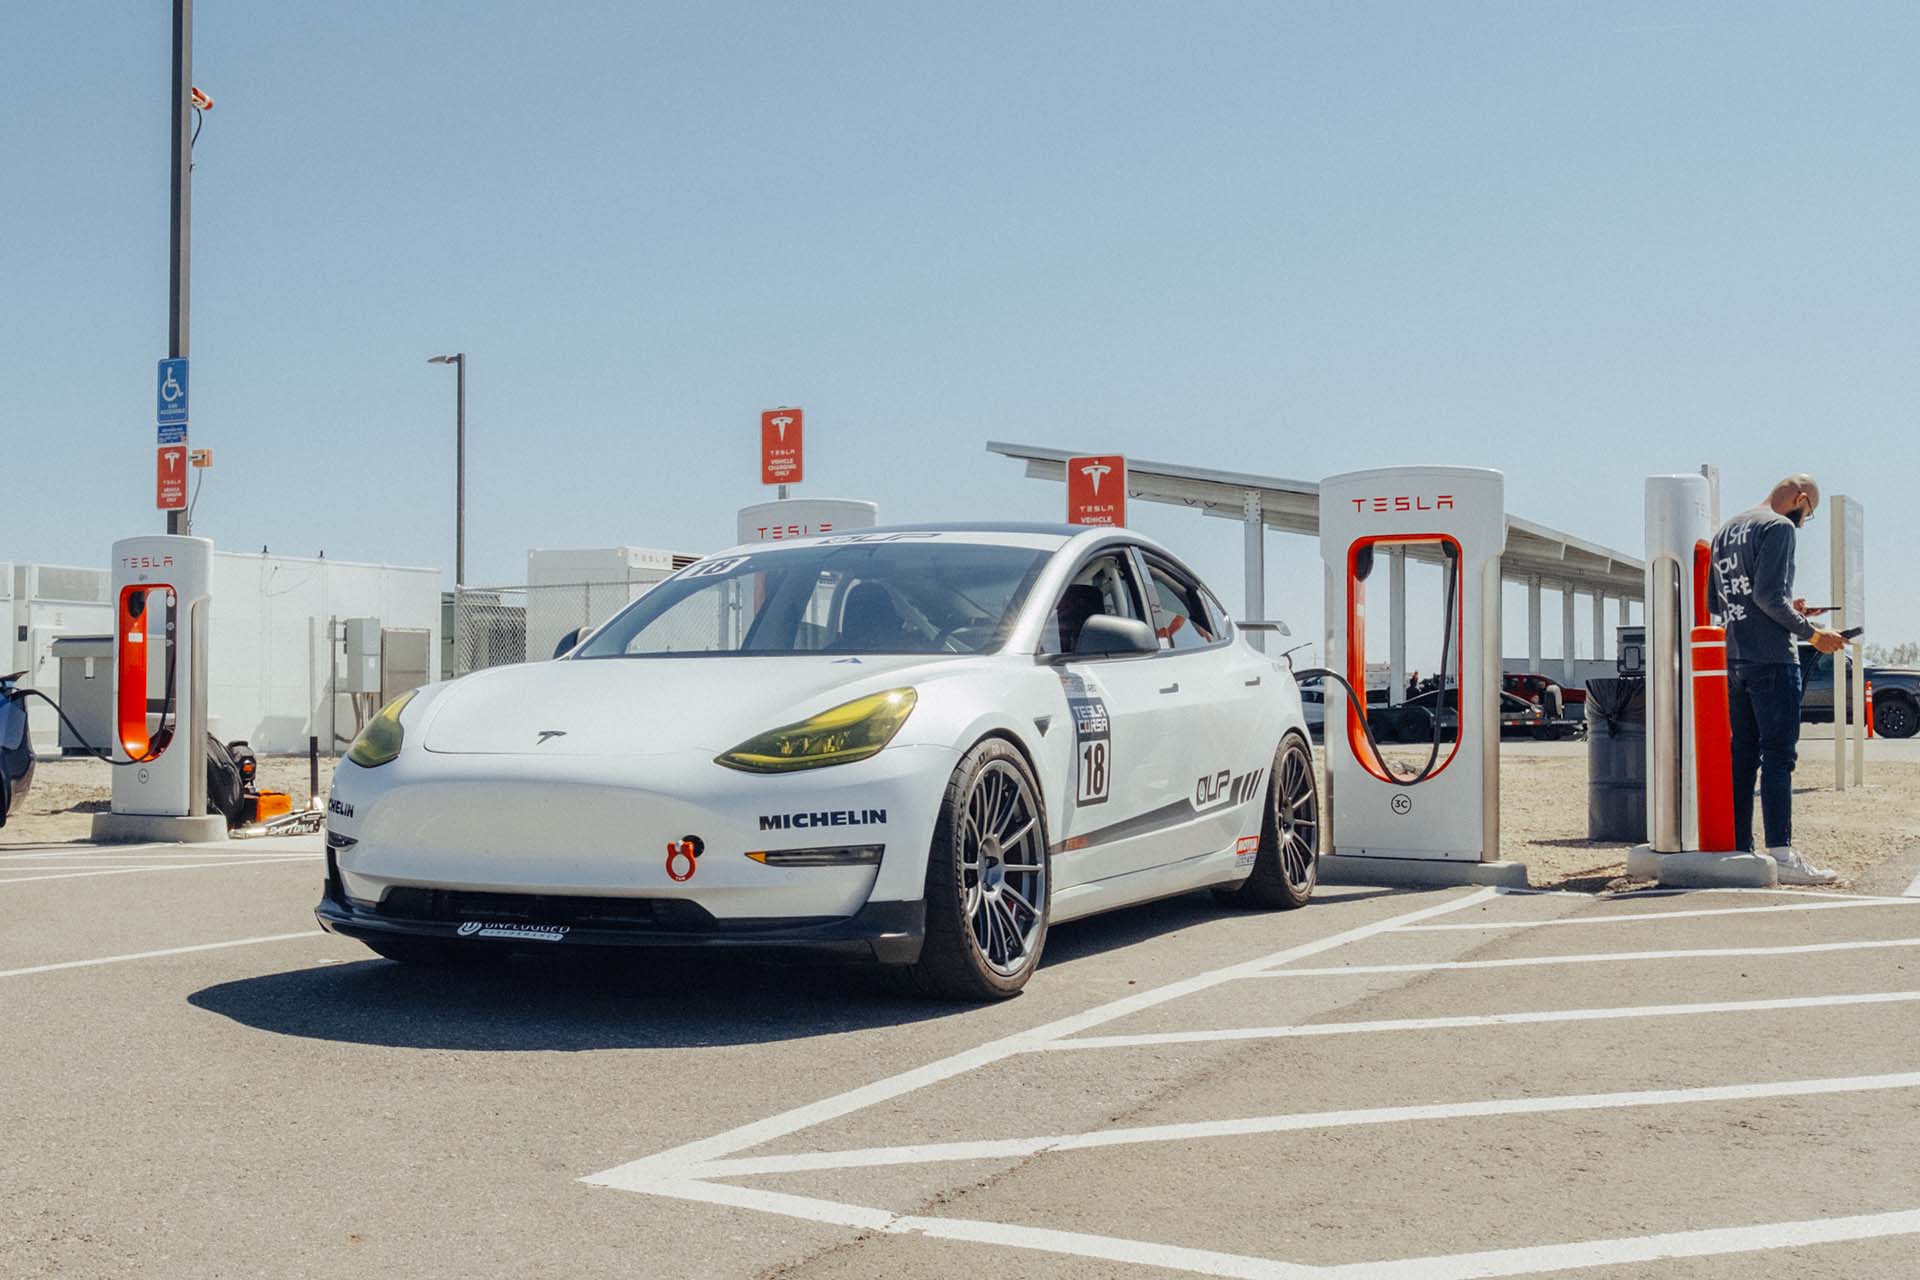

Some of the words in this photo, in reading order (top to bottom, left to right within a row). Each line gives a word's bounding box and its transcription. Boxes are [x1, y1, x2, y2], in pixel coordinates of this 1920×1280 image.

[1079, 504, 1114, 513] TESLA
[1351, 495, 1454, 513] TESLA
[1080, 516, 1113, 524] VEHICLE
[121, 556, 174, 569] TESLA
[1072, 703, 1107, 721] TESLA
[1078, 717, 1109, 734] CORSA
[1083, 742, 1105, 796] 18
[1394, 799, 1408, 809] 3C
[759, 809, 887, 831] MICHELIN
